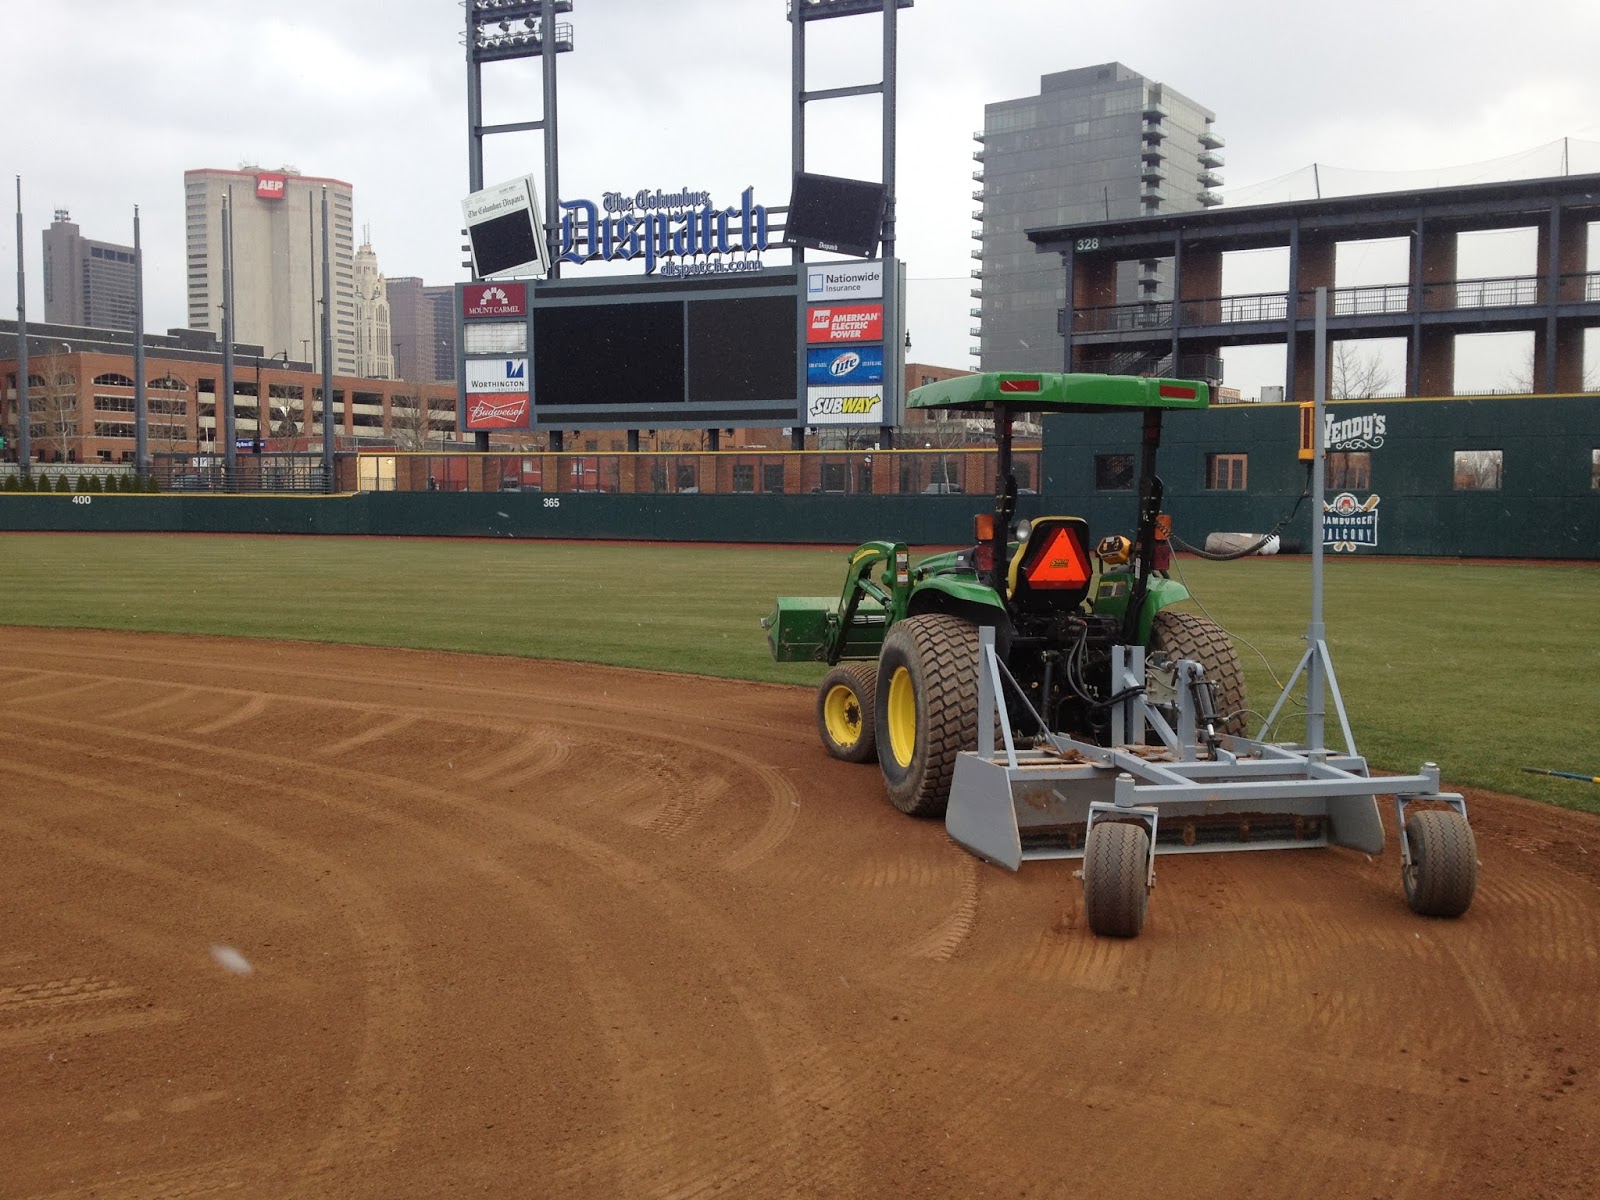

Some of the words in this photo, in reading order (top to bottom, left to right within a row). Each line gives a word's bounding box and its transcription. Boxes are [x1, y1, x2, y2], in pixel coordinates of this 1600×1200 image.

[258, 180, 283, 191] AEP
[602, 190, 633, 212] The
[635, 186, 710, 210] Columbus
[468, 210, 478, 219] The
[478, 202, 502, 215] Columbus
[502, 194, 525, 207] Dispatch
[555, 185, 769, 275] Dispatch
[1076, 238, 1100, 251] 328
[661, 258, 764, 278] dispatch.com
[826, 272, 880, 283] Nationwide
[469, 306, 493, 314] MOUNT
[493, 305, 520, 313] CARMEL
[814, 315, 830, 323] AEP
[832, 313, 878, 323] AMERICAN
[832, 321, 868, 330] ELECTRIC
[830, 330, 861, 338] POWER
[810, 394, 881, 416] SUBWAY
[469, 406, 525, 417] Budweiser
[72, 495, 92, 505] 400
[543, 497, 560, 508] 365
